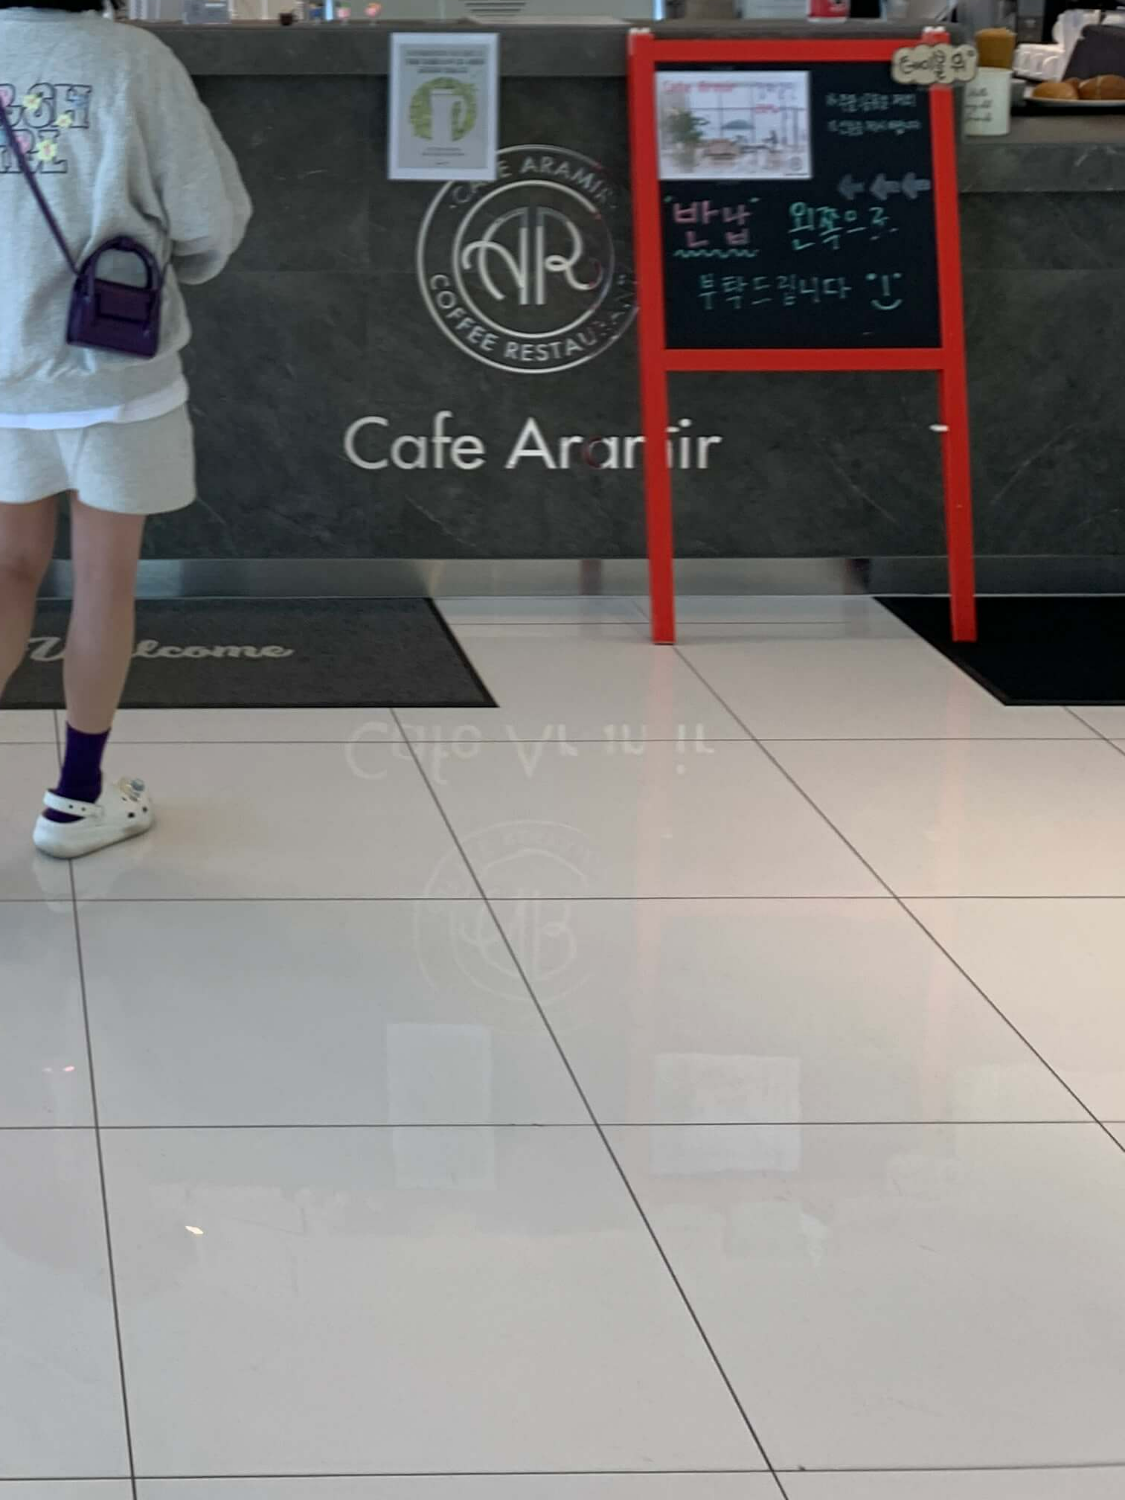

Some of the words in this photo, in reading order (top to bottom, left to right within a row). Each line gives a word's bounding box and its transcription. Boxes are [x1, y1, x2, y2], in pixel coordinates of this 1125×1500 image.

[429, 273, 500, 353] COFFEE
[698, 273, 854, 311] 부탁드립니다
[343, 410, 487, 470] Cafe
